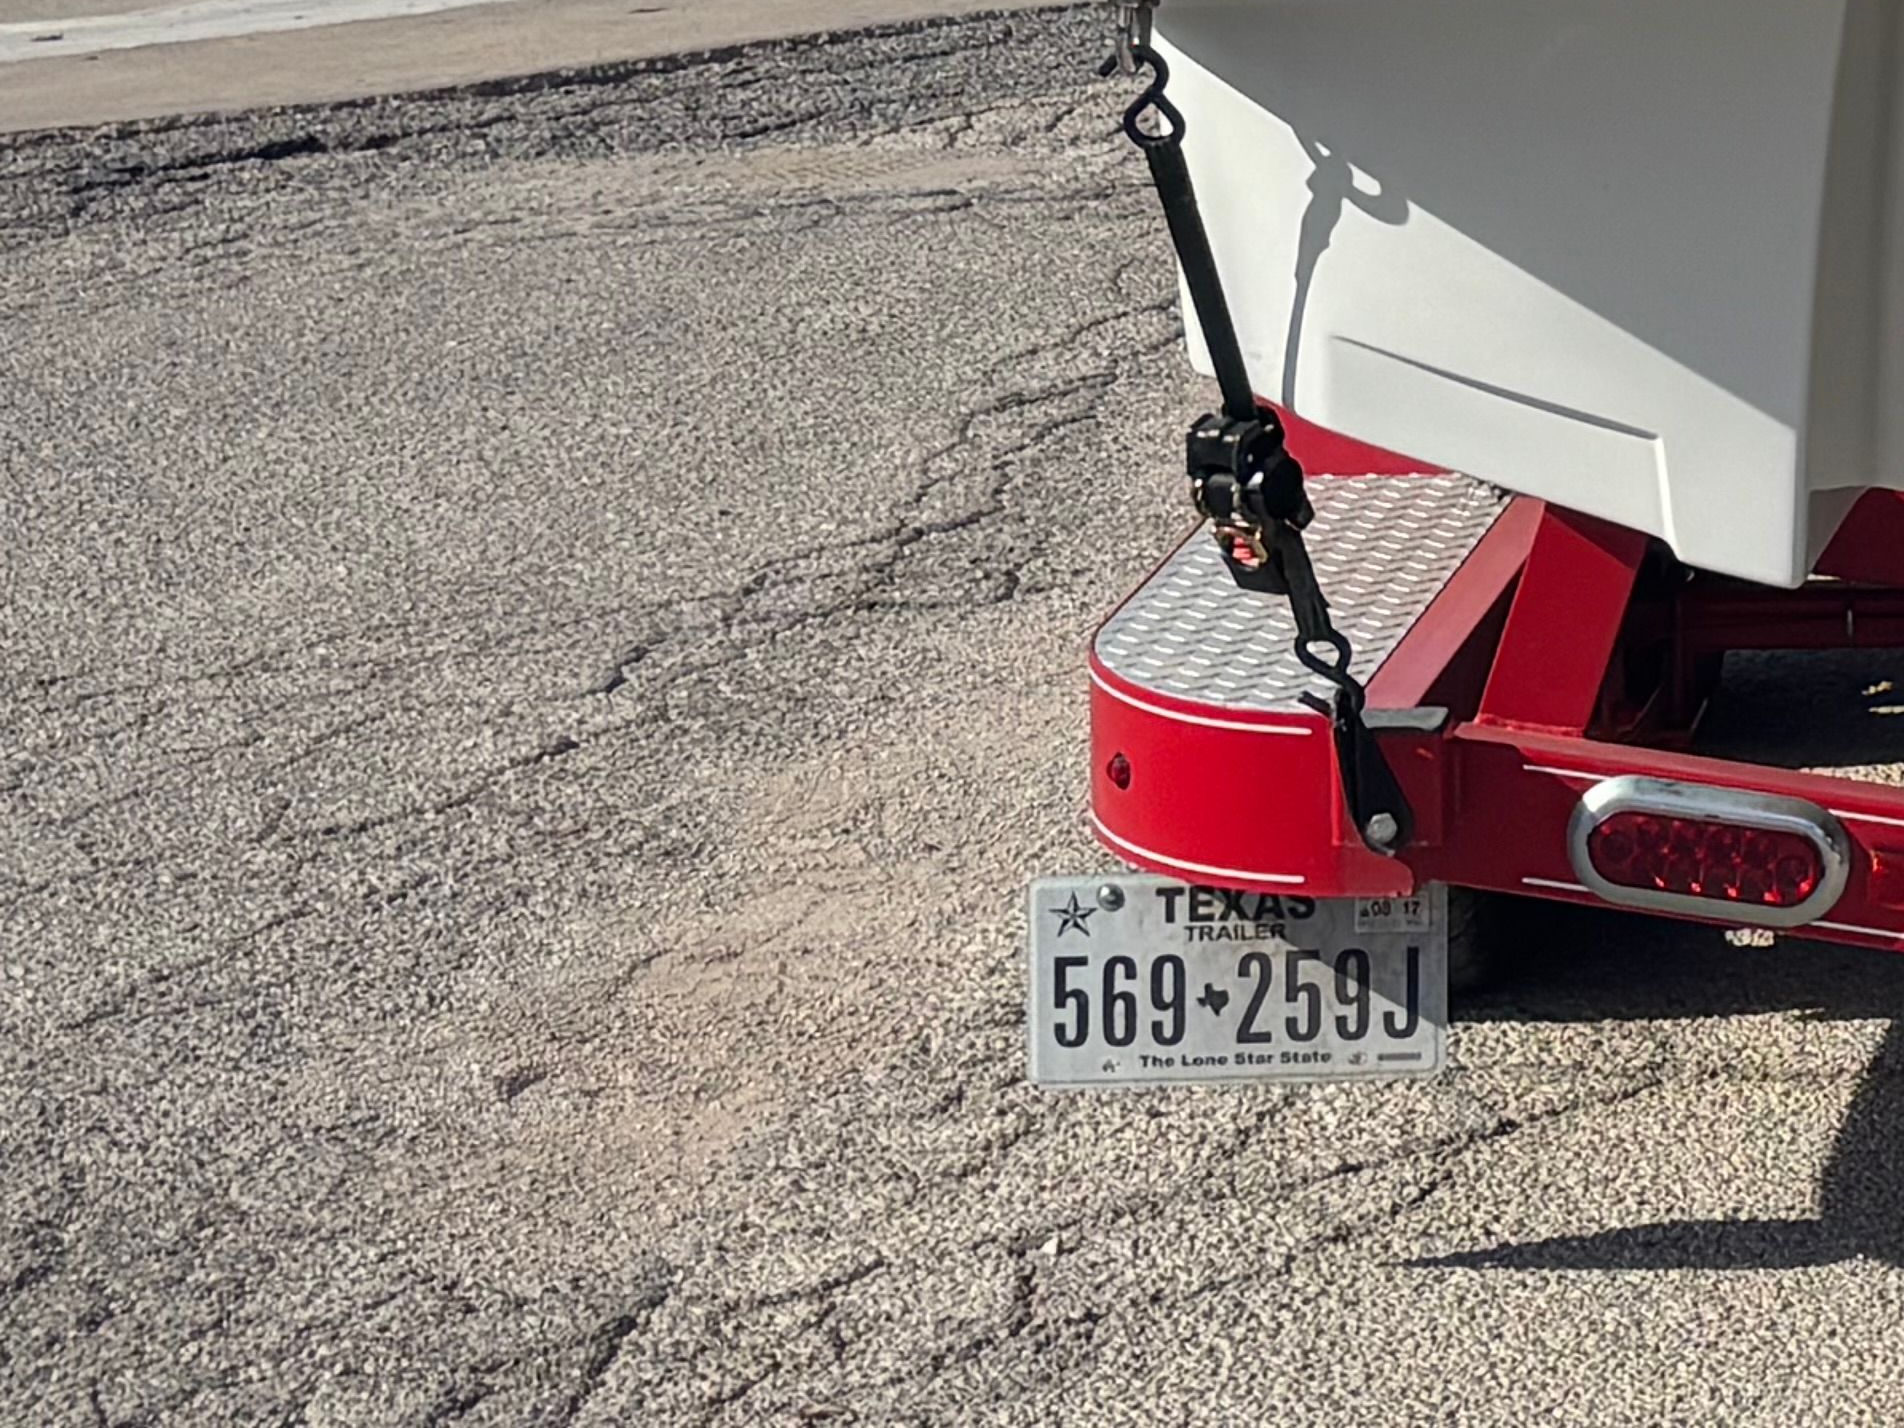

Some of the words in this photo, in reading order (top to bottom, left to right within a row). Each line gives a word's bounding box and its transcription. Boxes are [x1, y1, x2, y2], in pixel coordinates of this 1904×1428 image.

[1156, 885, 1315, 923] TEXAS
[1184, 924, 1287, 942] TRAILER
[1054, 953, 1187, 1048] 569
[1236, 946, 1420, 1044] 259J
[1139, 1054, 1175, 1068] The
[1181, 1053, 1229, 1067] Lone
[1234, 1051, 1274, 1066] Star
[1280, 1049, 1333, 1064] State
